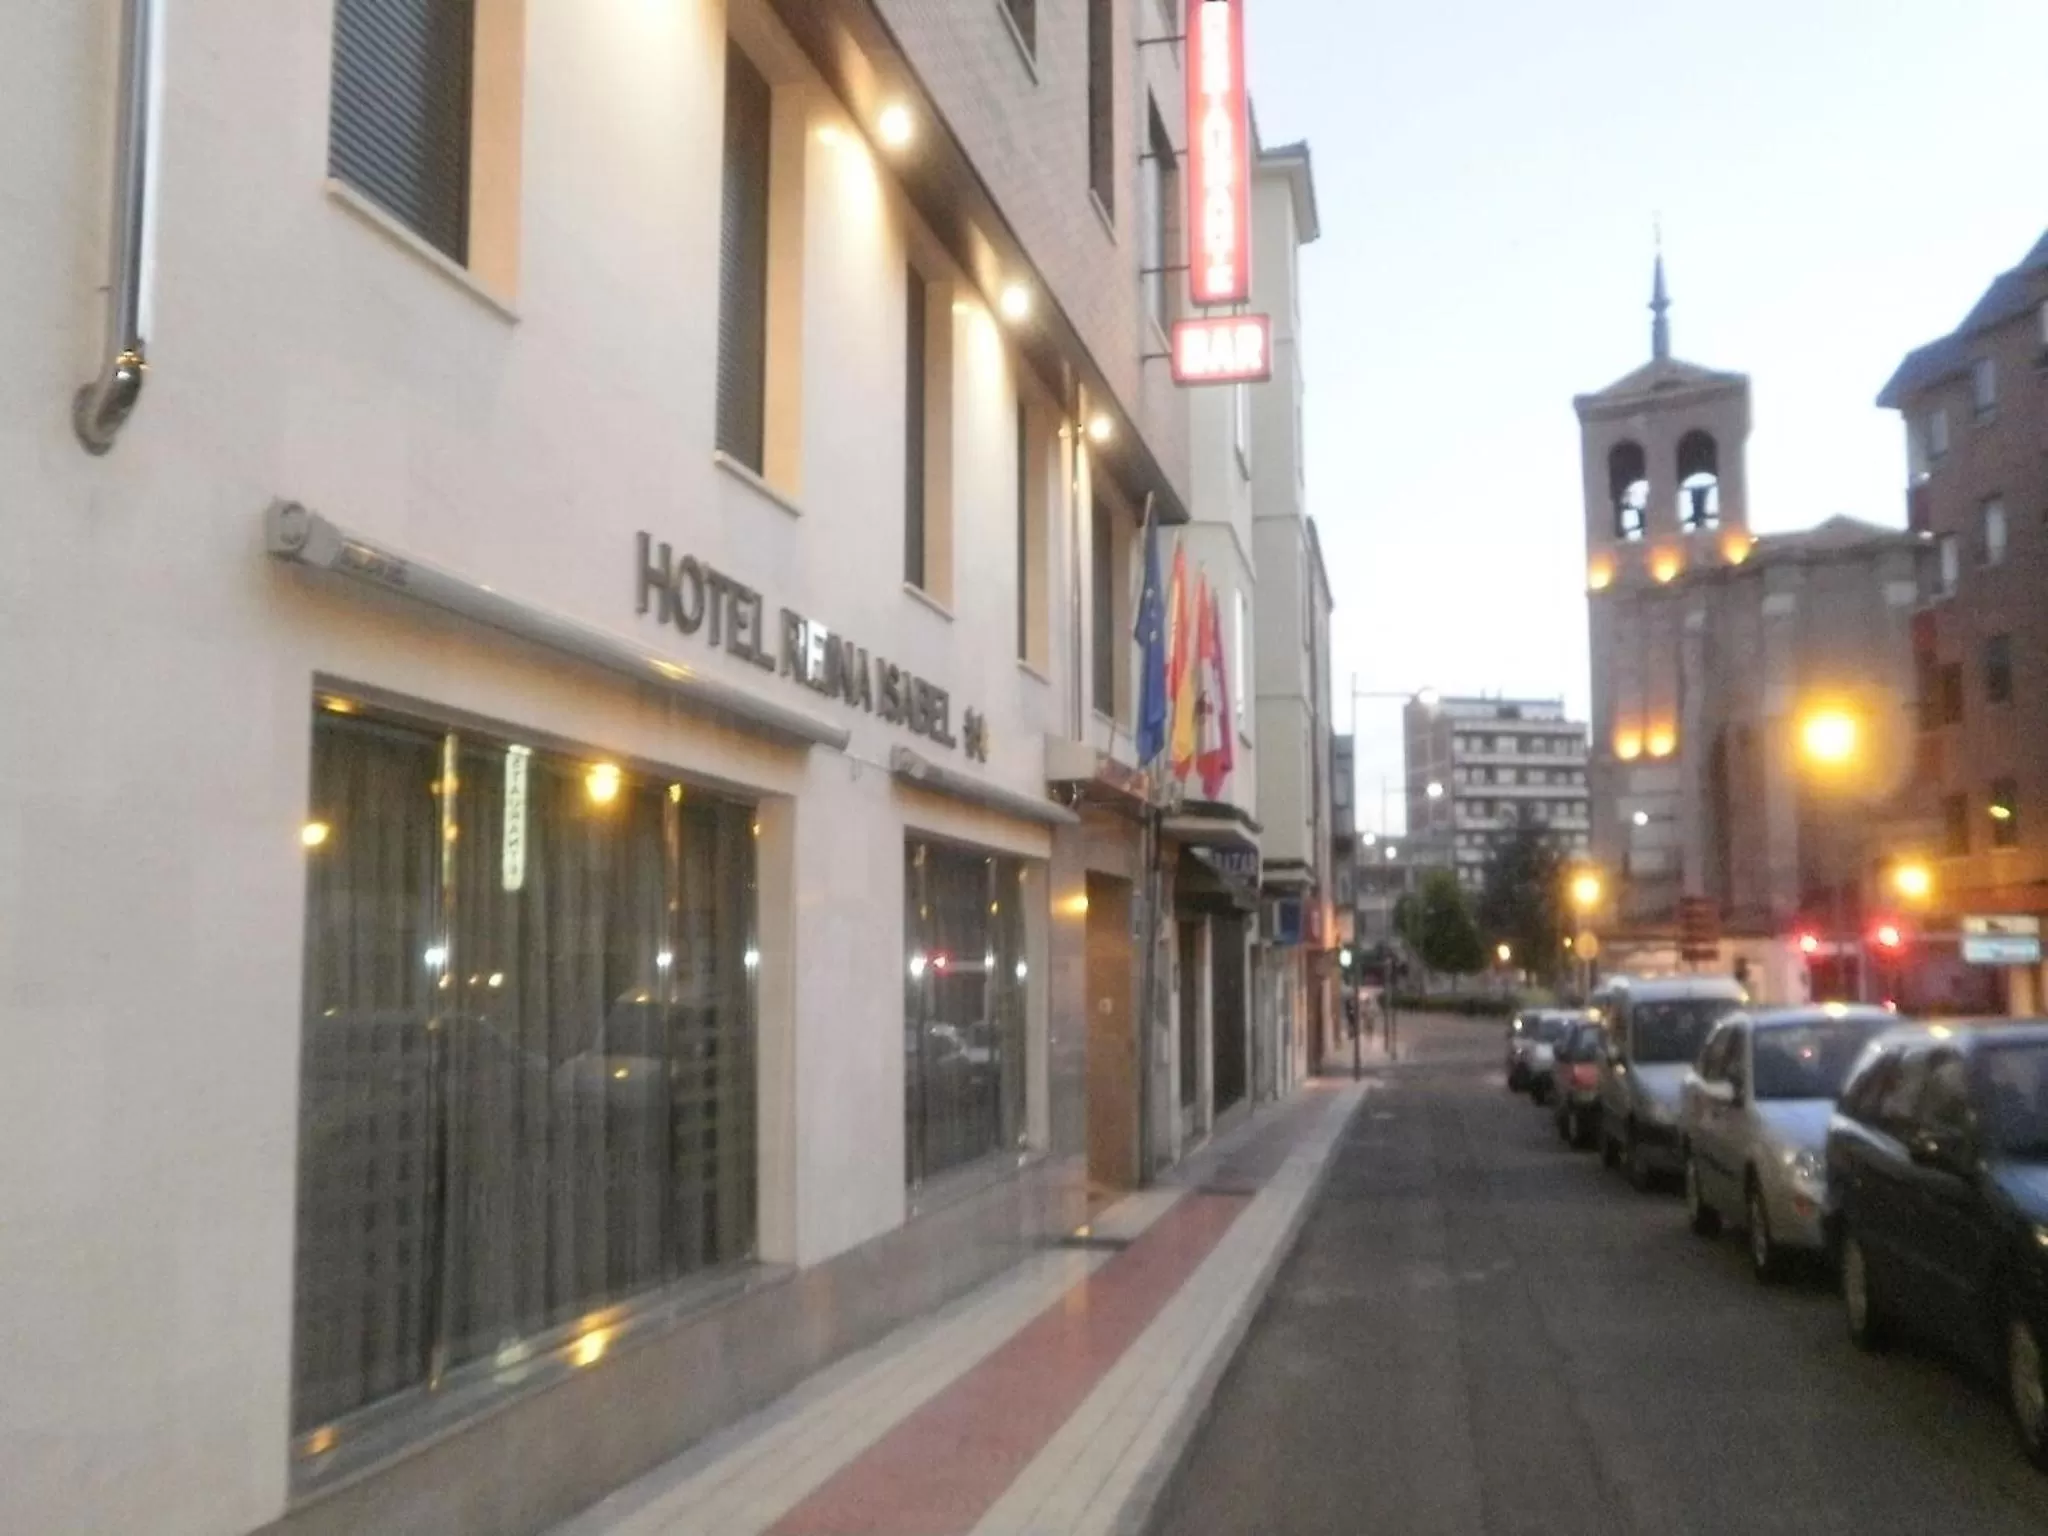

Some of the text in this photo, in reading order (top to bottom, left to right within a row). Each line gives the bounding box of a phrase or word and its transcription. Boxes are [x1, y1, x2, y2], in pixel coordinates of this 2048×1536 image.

[1178, 323, 1264, 374] BAR
[635, 529, 957, 750] HOTEL REINA ISABEL
